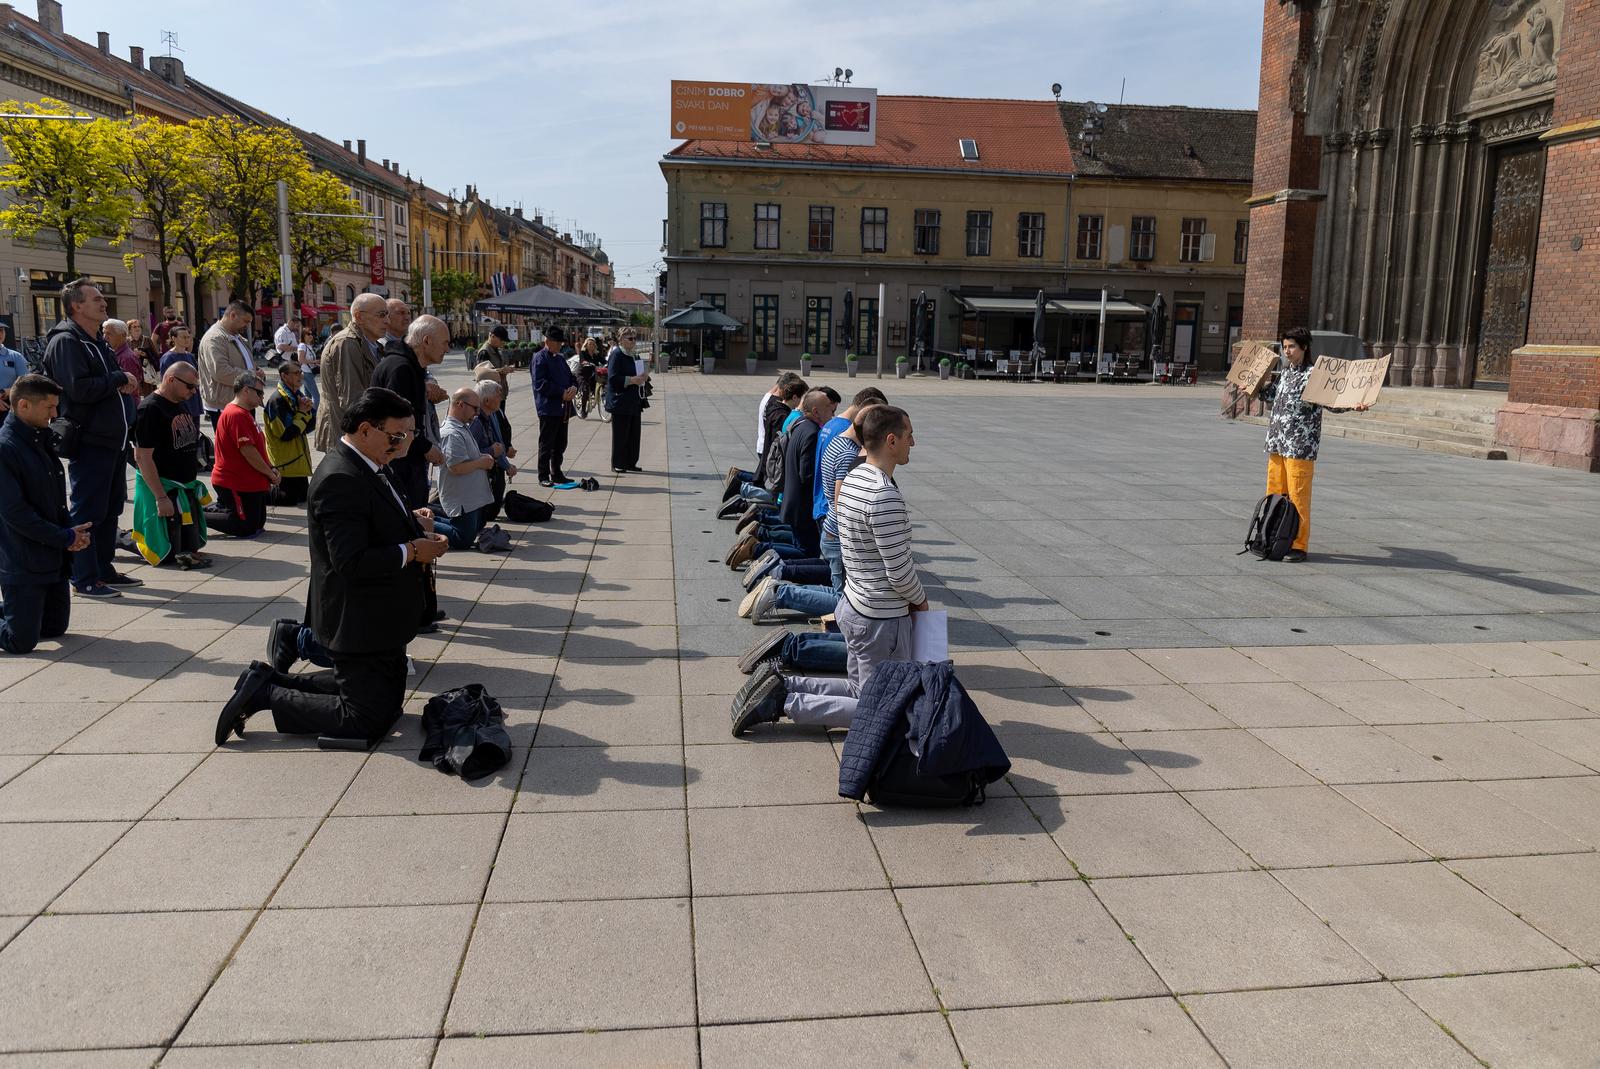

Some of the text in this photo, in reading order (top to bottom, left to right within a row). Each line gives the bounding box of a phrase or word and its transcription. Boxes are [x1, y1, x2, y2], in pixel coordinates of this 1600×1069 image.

[708, 87, 745, 97] DOBRO
[676, 99, 729, 111] SVAKI DAN
[1318, 357, 1347, 375] MOJA
[1324, 377, 1349, 394] MOJ
